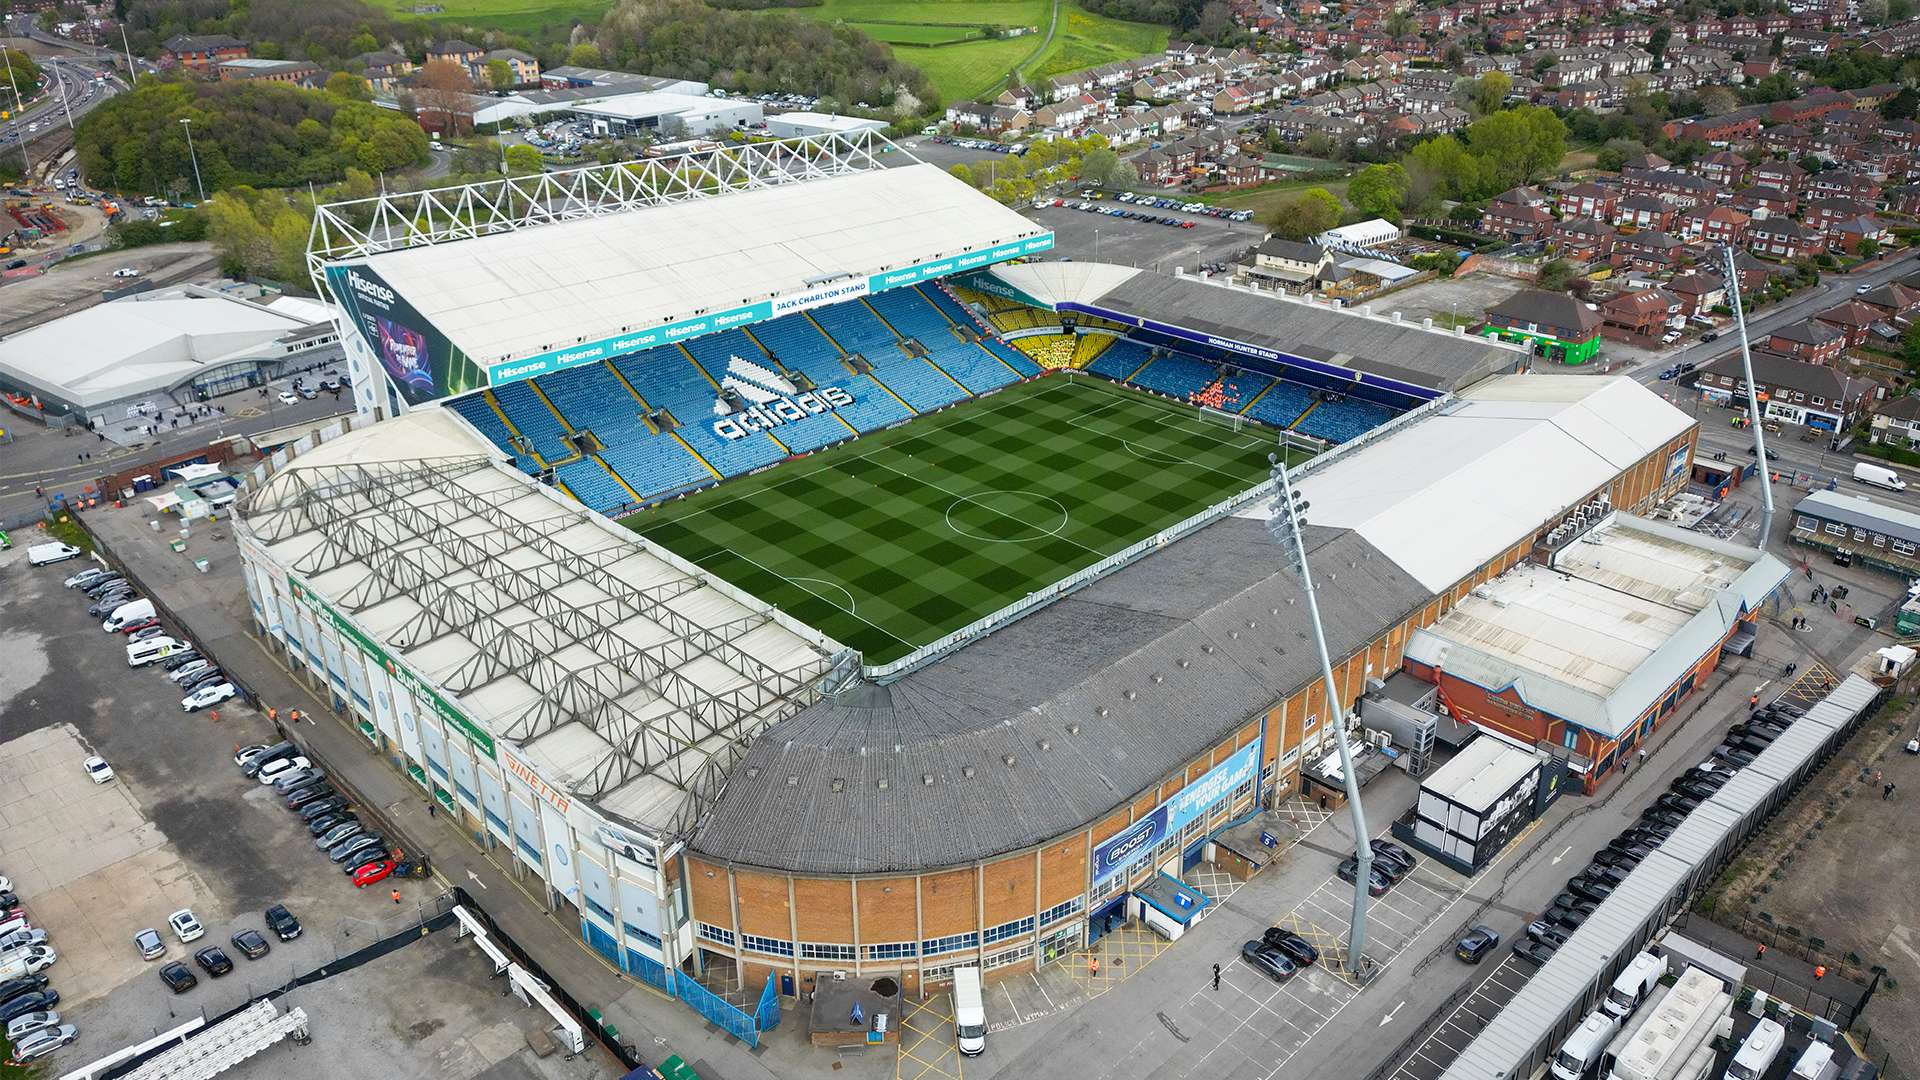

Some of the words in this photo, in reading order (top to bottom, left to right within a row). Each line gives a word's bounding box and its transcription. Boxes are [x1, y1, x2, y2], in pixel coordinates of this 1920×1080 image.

[992, 246, 1020, 259] Hisense
[1025, 238, 1051, 251] Hisense
[923, 263, 953, 276] Hisense
[958, 254, 987, 267] Hisense
[347, 269, 395, 304] Hisense
[885, 271, 917, 285] Hisense
[973, 277, 1015, 297] Hisense
[776, 299, 797, 311] JACK
[799, 289, 840, 305] CHARLTON
[841, 283, 866, 295] STAND
[714, 311, 753, 327] Hisense
[665, 322, 706, 339] Hisense
[612, 333, 656, 351] Hisense
[1208, 337, 1233, 349] NORMAN
[1234, 343, 1257, 355] HUNTER
[1258, 350, 1279, 360] STAND
[556, 346, 603, 365] Hisense
[497, 360, 546, 379] Hisense
[713, 386, 854, 439] adidas
[300, 587, 336, 628] Burflex
[394, 663, 437, 711] Burflex
[504, 751, 570, 813] GINETTA
[1111, 826, 1153, 861] BOOST
[990, 1018, 1017, 1031] POLICE
